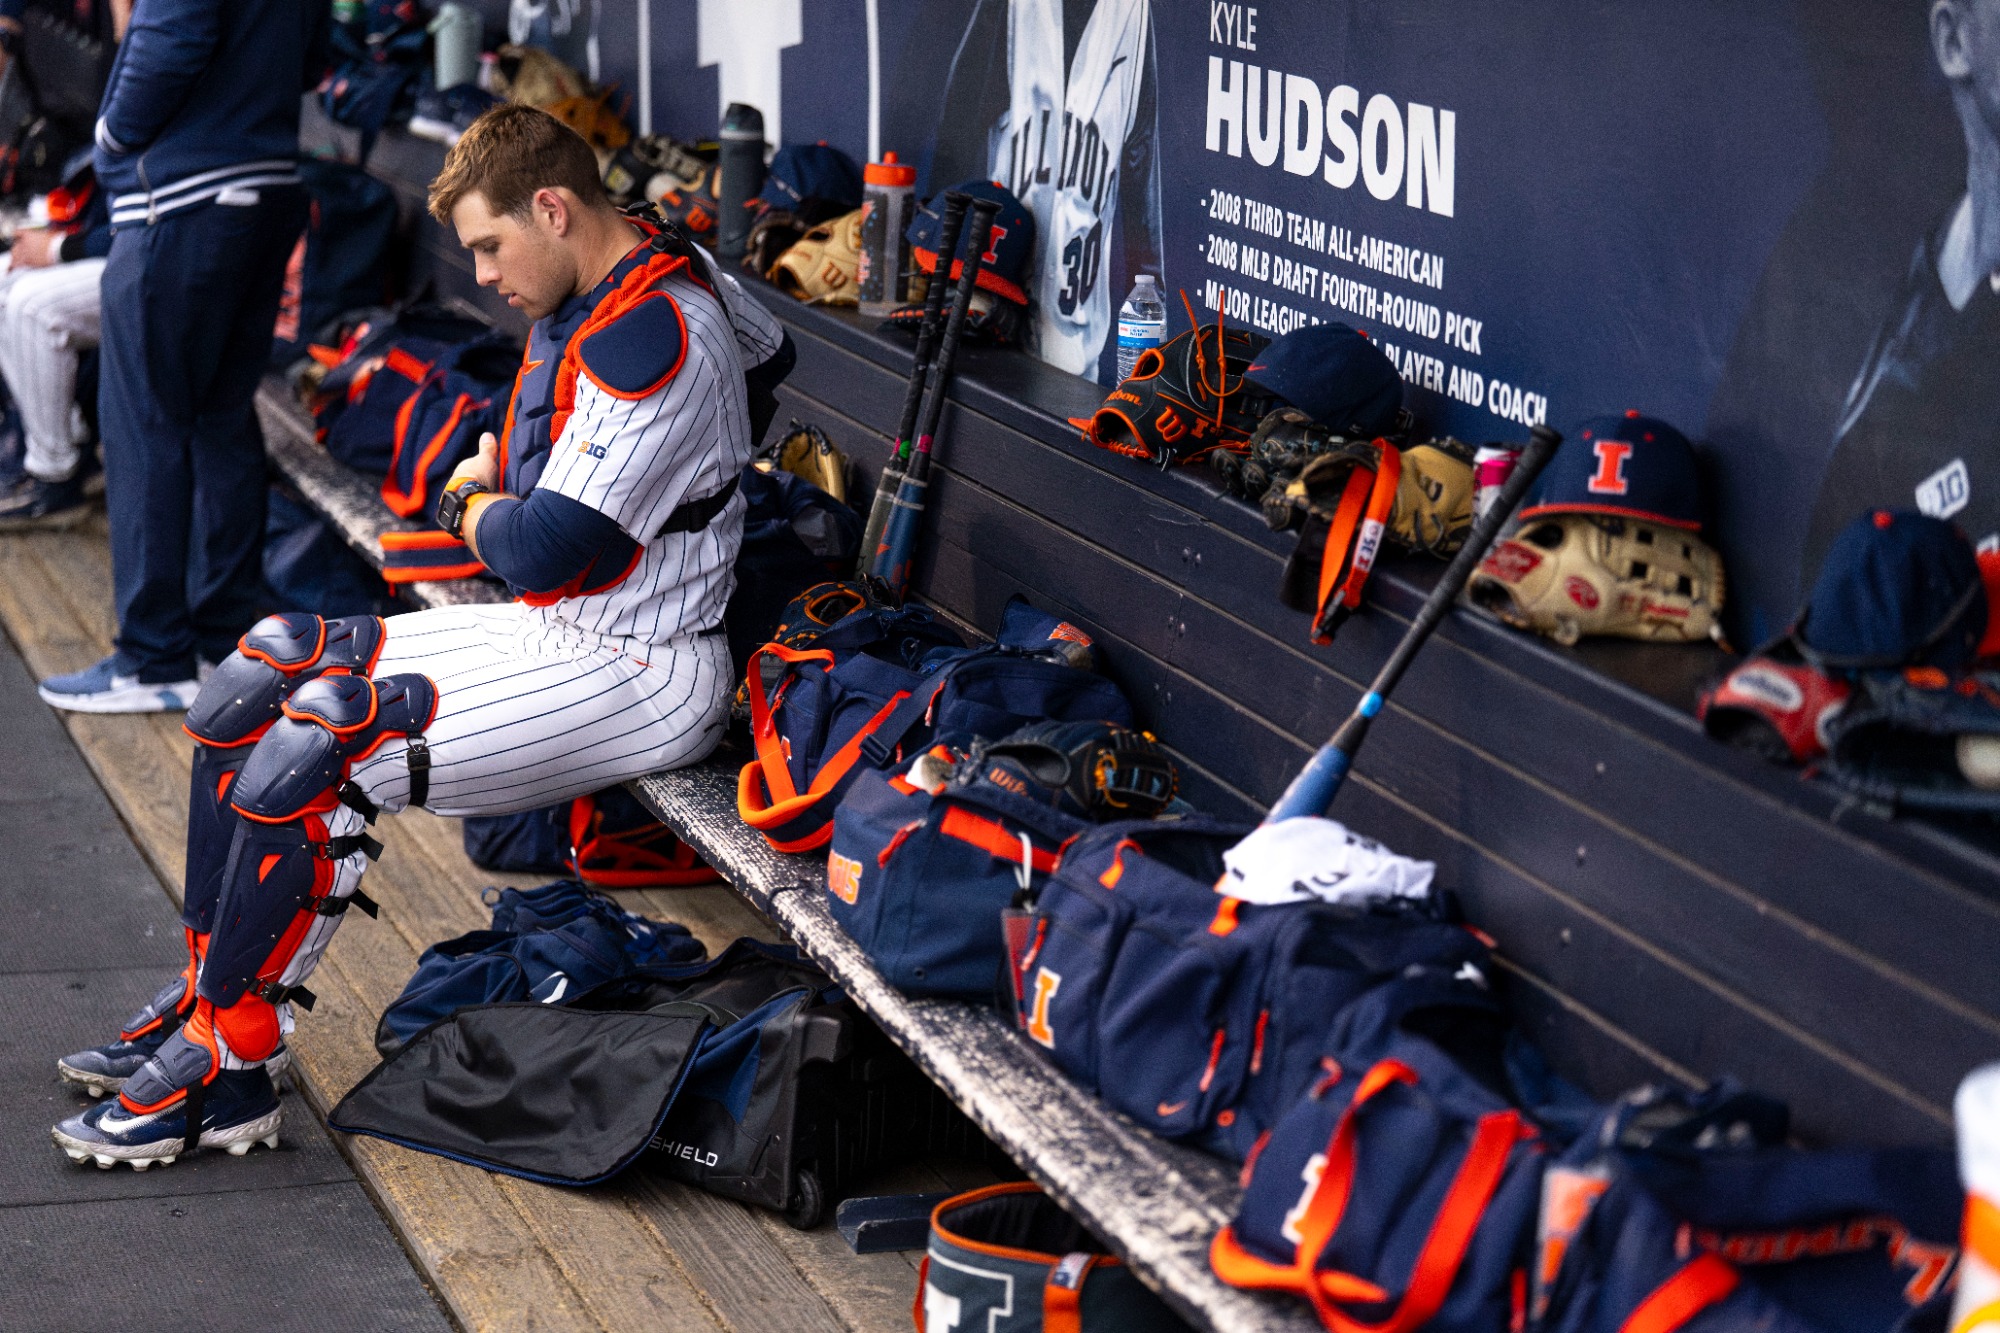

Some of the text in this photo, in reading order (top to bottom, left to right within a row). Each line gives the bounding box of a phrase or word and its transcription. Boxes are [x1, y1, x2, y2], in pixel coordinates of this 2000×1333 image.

[1210, 0, 1257, 51] KYLE
[1206, 55, 1456, 218] HUDSON
[1058, 217, 1103, 316] 30
[1209, 188, 1444, 290] 2008 THIRD TEAM ALL-AMERICAN
[1205, 279, 1250, 323] MAJOR
[1253, 296, 1307, 336] LEAGUE
[1206, 233, 1238, 271] 2008
[1240, 244, 1270, 281] MLB
[1272, 255, 1319, 299] DRAFT
[1321, 271, 1441, 340] FOURTH-ROUND
[1444, 311, 1483, 355] PICK
[1385, 342, 1547, 427] PLAYER AND COACH
[1588, 440, 1633, 495] I
[1027, 966, 1061, 1050] I
[649, 1135, 718, 1167] SHIELD
